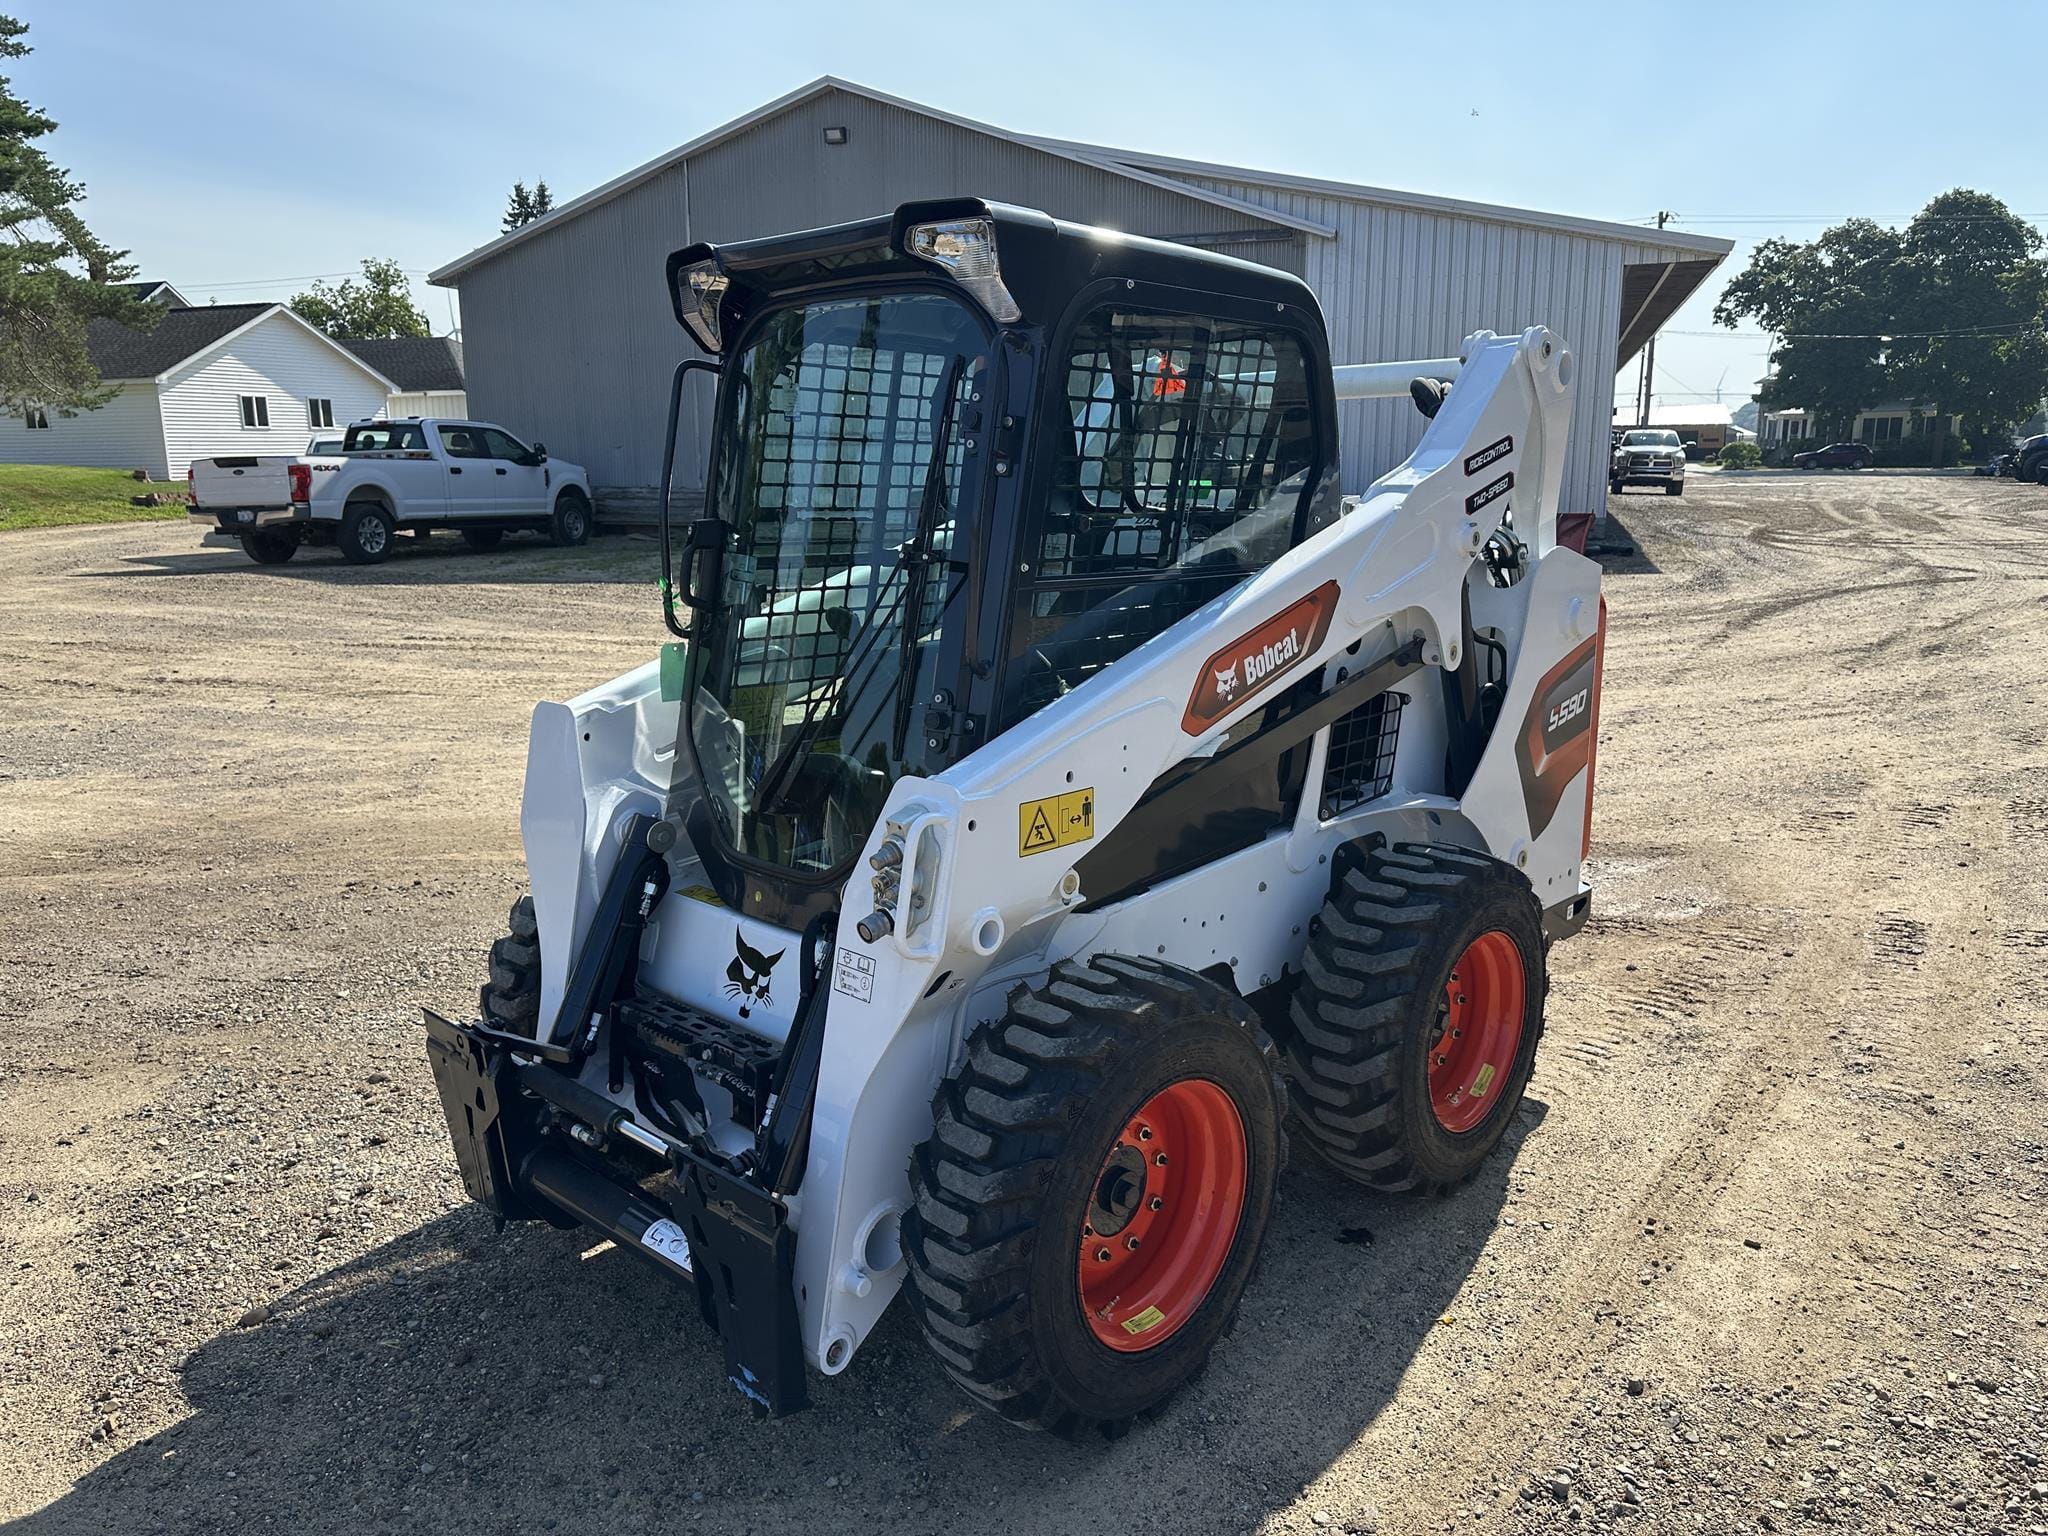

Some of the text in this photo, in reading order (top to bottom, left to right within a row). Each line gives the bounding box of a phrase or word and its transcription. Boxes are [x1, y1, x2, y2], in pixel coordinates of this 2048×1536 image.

[1469, 440, 1511, 471] RIDE CONTROL
[1473, 477, 1509, 508] TWO-SPEED
[1243, 627, 1299, 686] Bobcat
[1548, 688, 1588, 732] S590
